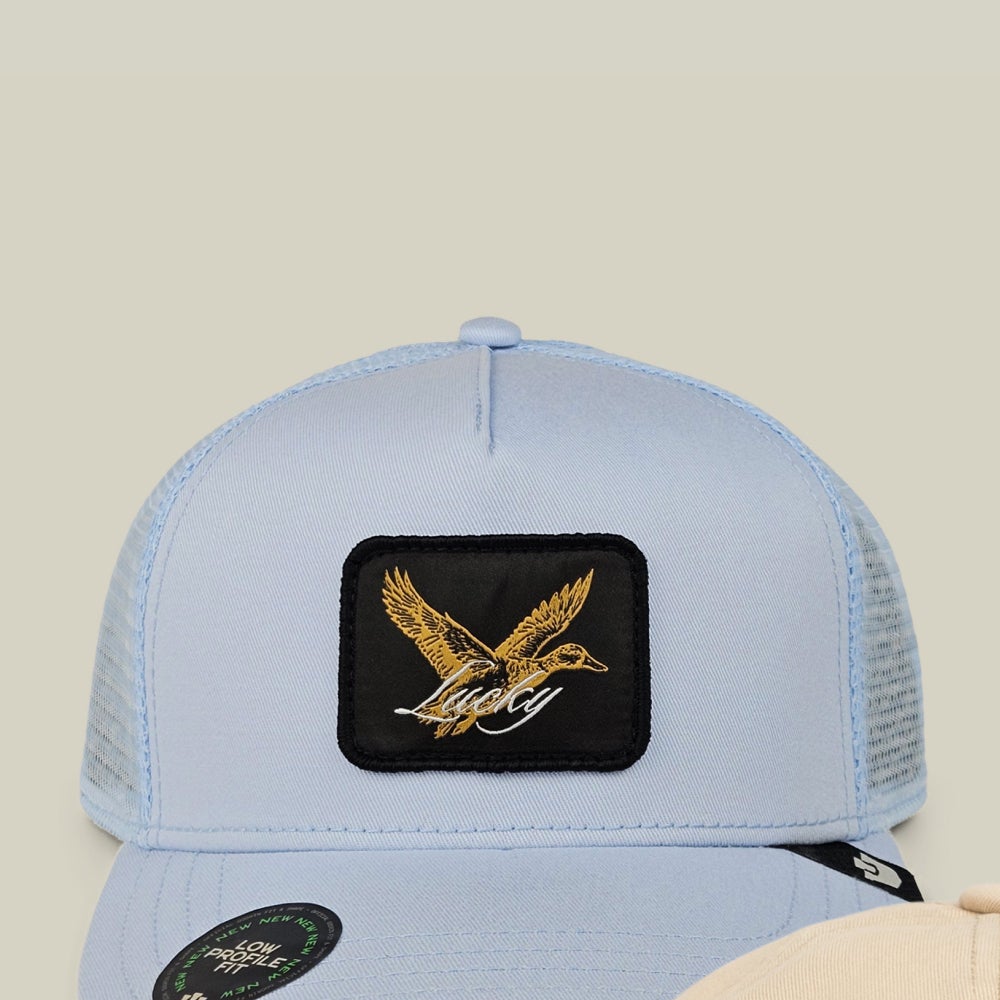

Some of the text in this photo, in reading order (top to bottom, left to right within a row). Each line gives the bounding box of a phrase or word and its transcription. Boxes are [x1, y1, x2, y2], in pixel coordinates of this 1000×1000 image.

[394, 660, 564, 735] Lucky
[259, 915, 295, 925] NEW
[295, 917, 318, 933] NEW
[216, 922, 253, 942] NEW
[234, 939, 282, 955] LOW
[301, 934, 319, 956] NEW
[183, 944, 210, 969] NEW
[203, 948, 288, 969] PROFILE
[213, 961, 250, 975] FIT
[268, 959, 302, 981] NEW
[174, 972, 188, 993] NEW
[220, 981, 259, 999] NEW
